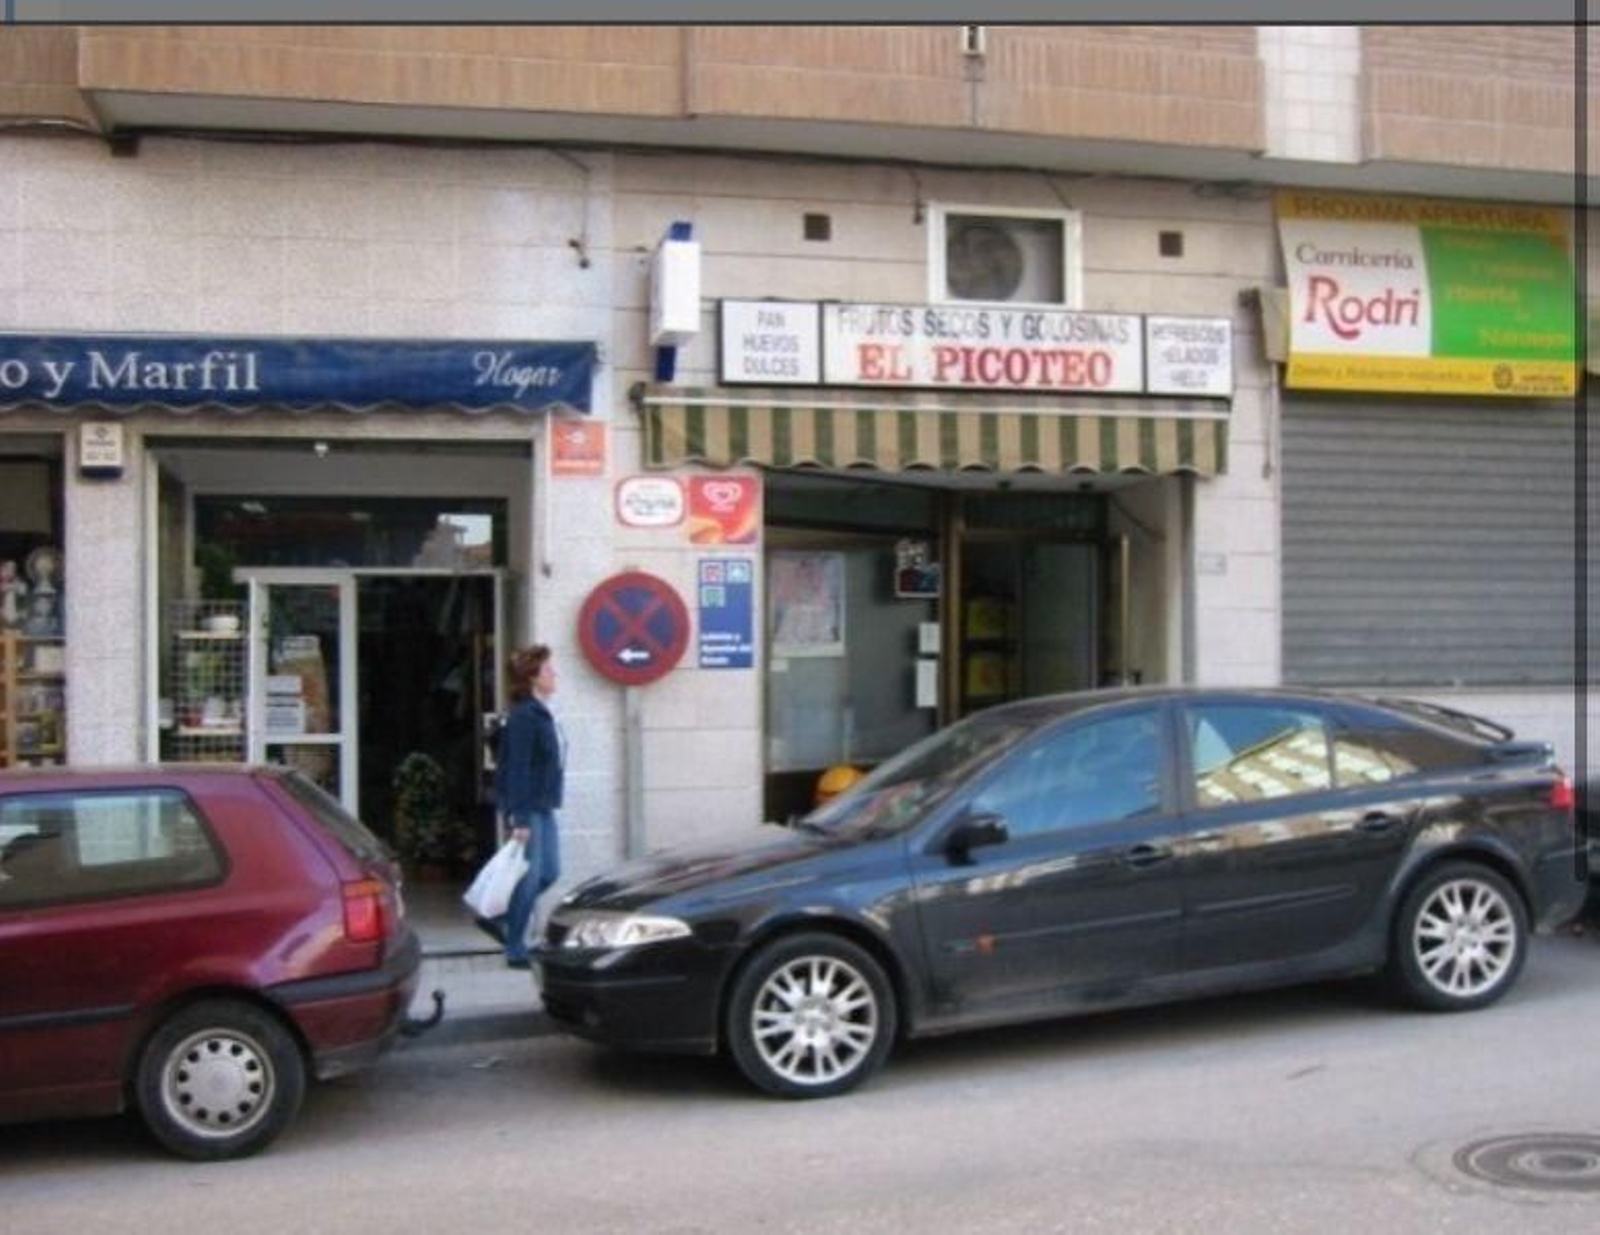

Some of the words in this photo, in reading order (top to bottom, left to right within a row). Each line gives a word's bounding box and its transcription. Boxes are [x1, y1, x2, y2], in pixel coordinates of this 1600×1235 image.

[923, 310, 991, 341] SECOS
[1001, 314, 1014, 340] Y
[1021, 313, 1130, 345] GOLOSINAS
[1304, 275, 1420, 341] Rodri
[44, 360, 75, 397] y
[88, 351, 261, 391] Marfil
[471, 350, 563, 398] Hogar
[743, 356, 799, 377] DULCES
[857, 344, 913, 382] EL
[932, 346, 1113, 387] PICOTEO
